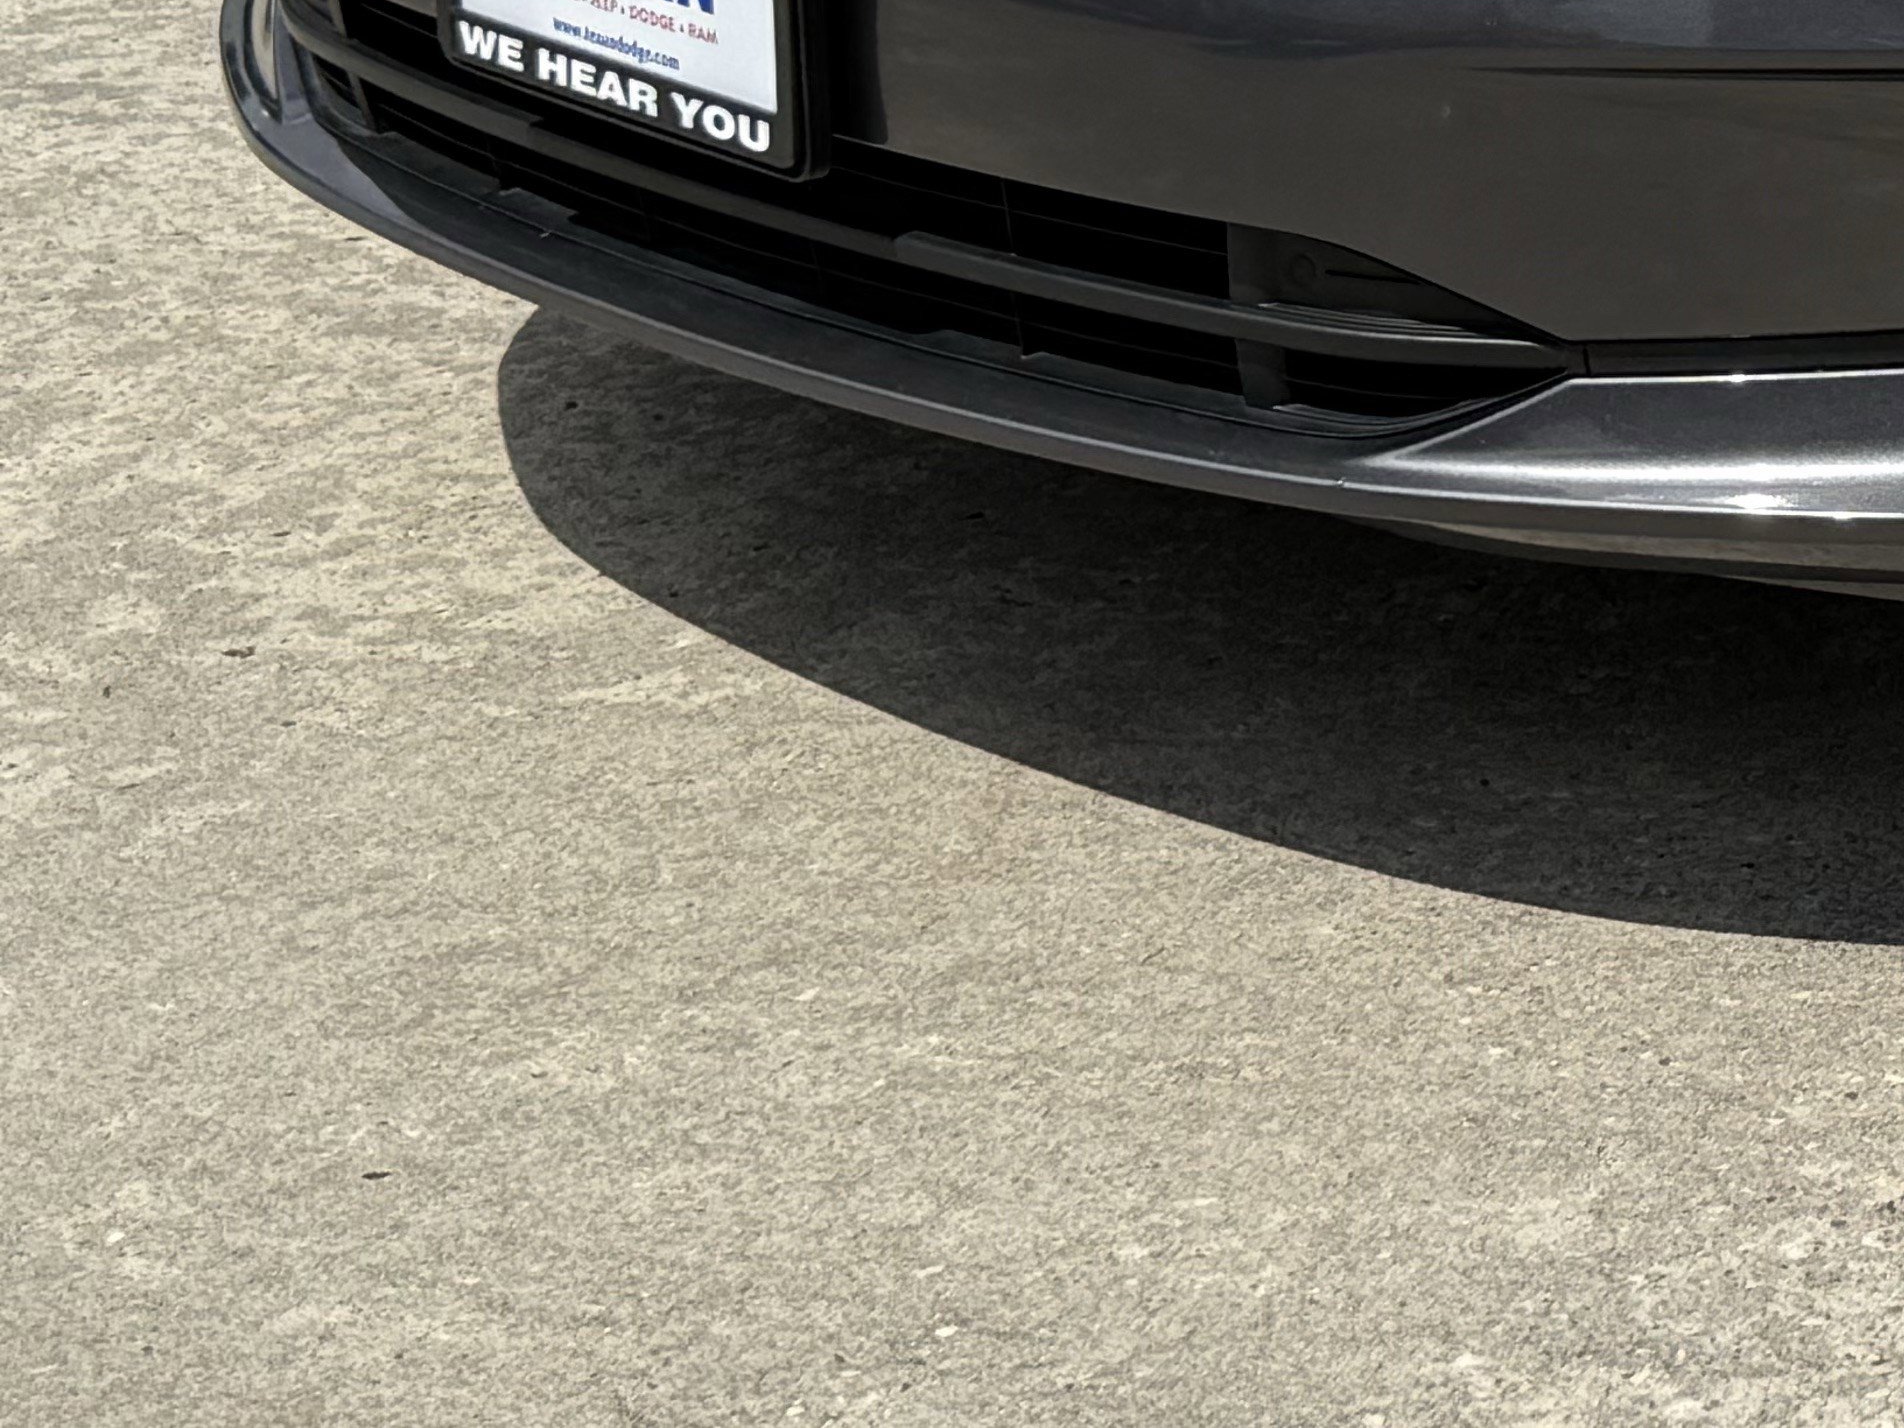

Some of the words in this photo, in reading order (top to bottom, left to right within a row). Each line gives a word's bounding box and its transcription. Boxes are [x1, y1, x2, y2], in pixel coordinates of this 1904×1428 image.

[629, 4, 676, 33] DODGE
[688, 22, 719, 45] RAM
[458, 20, 525, 73] WE
[537, 47, 659, 118] HEAR
[670, 91, 770, 153] YOU
